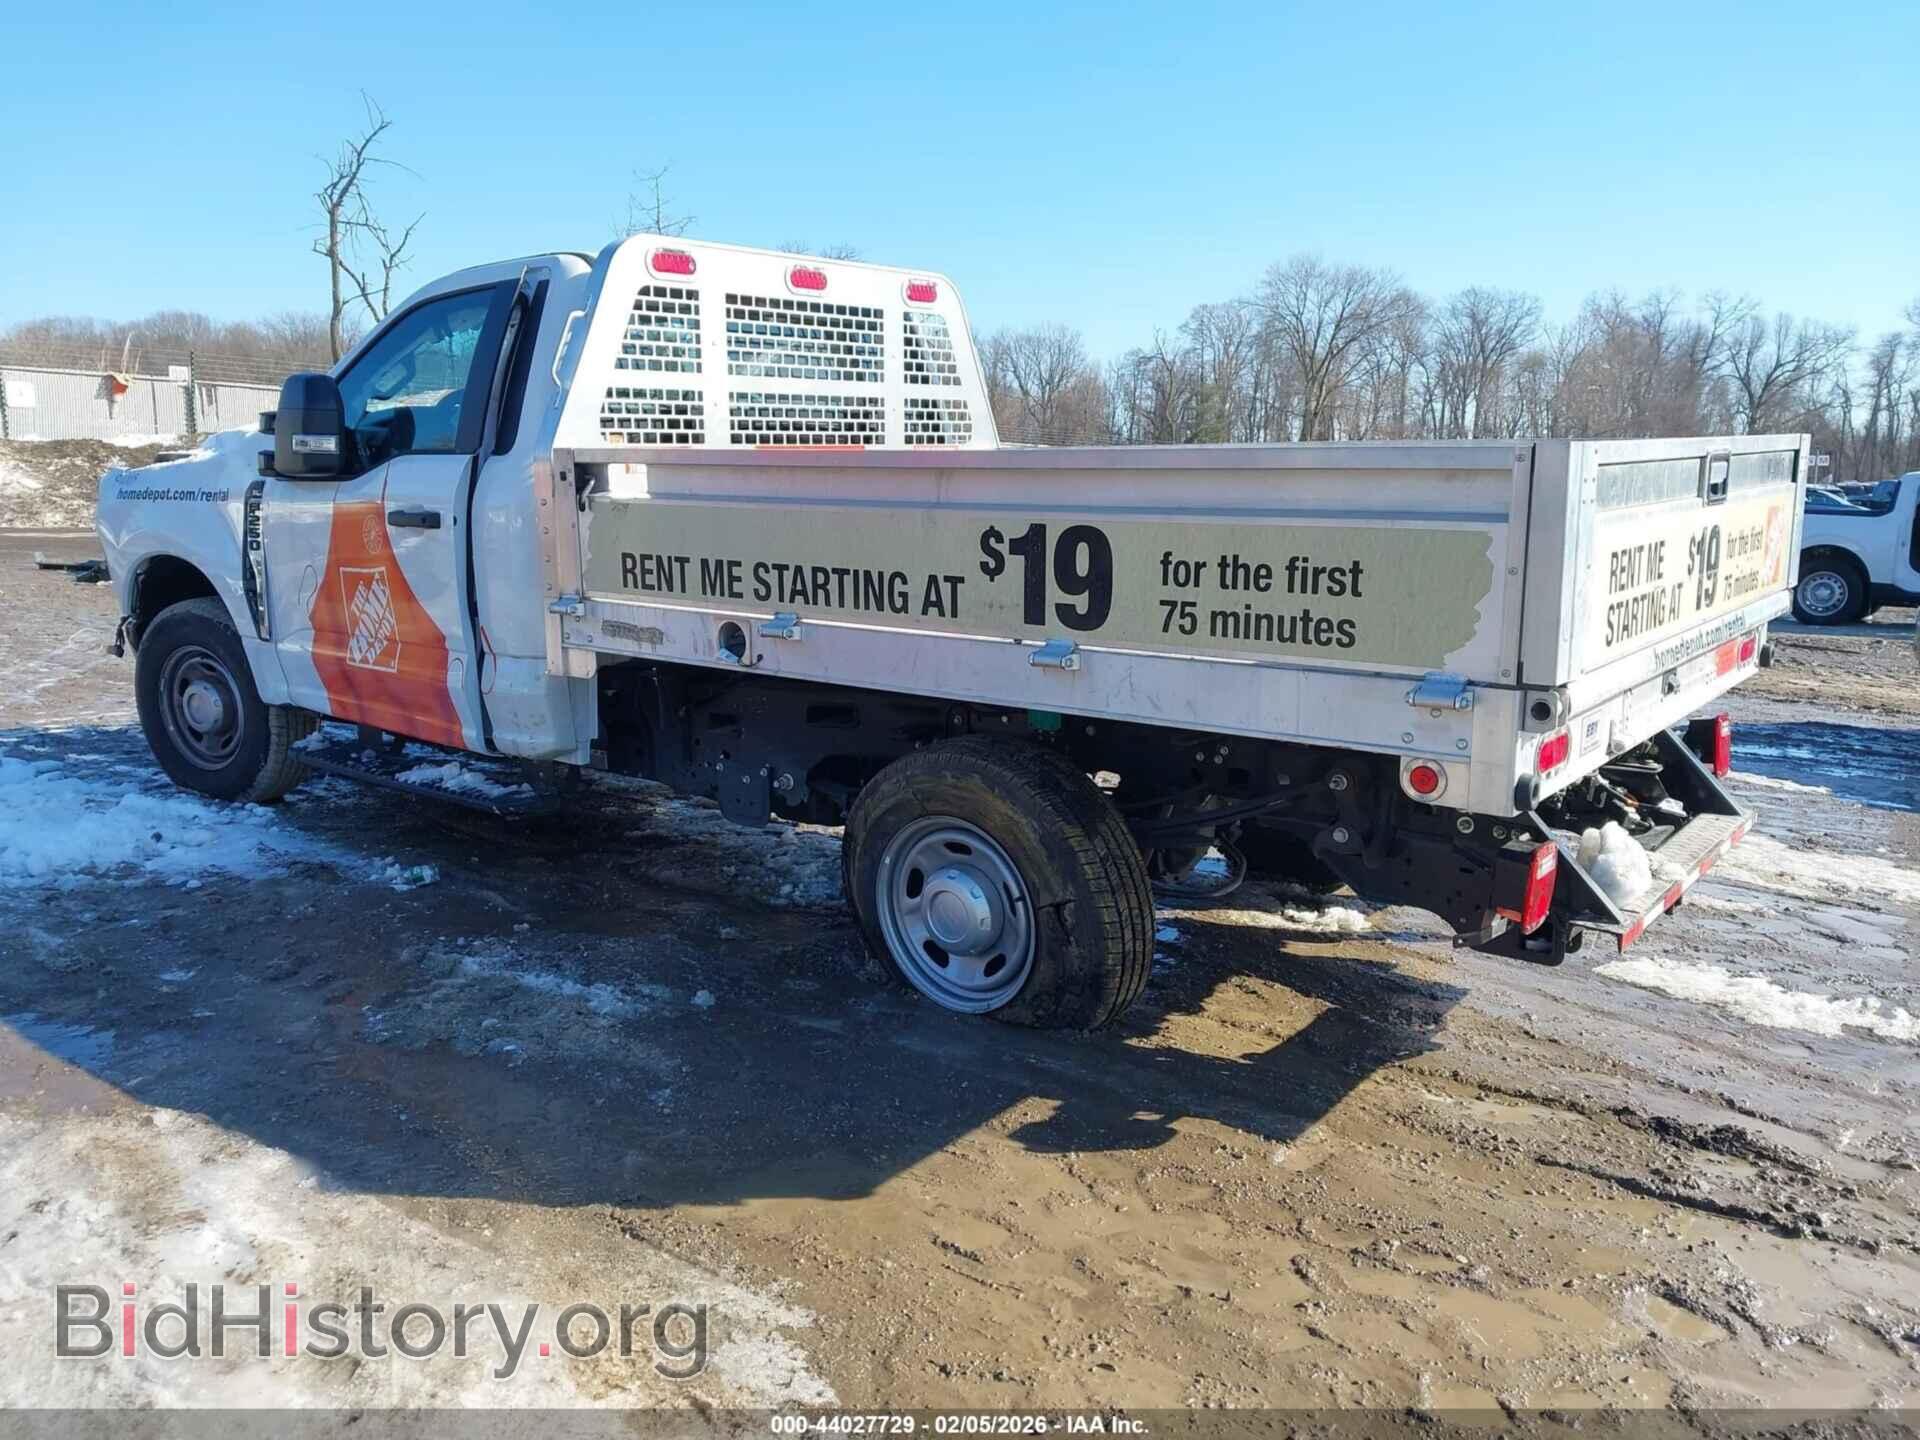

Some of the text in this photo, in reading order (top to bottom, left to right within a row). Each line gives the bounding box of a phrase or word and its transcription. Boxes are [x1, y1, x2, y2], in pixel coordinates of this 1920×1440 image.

[117, 488, 229, 502] homedepot.com/rental
[621, 523, 1112, 631] RENT ME STARTING AT $19
[1160, 551, 1363, 598] for the first
[1609, 540, 1665, 595] RENT ME
[1688, 524, 1720, 610] $19
[1159, 600, 1356, 648] 75 minutes
[1606, 582, 1683, 647] STARTING AT
